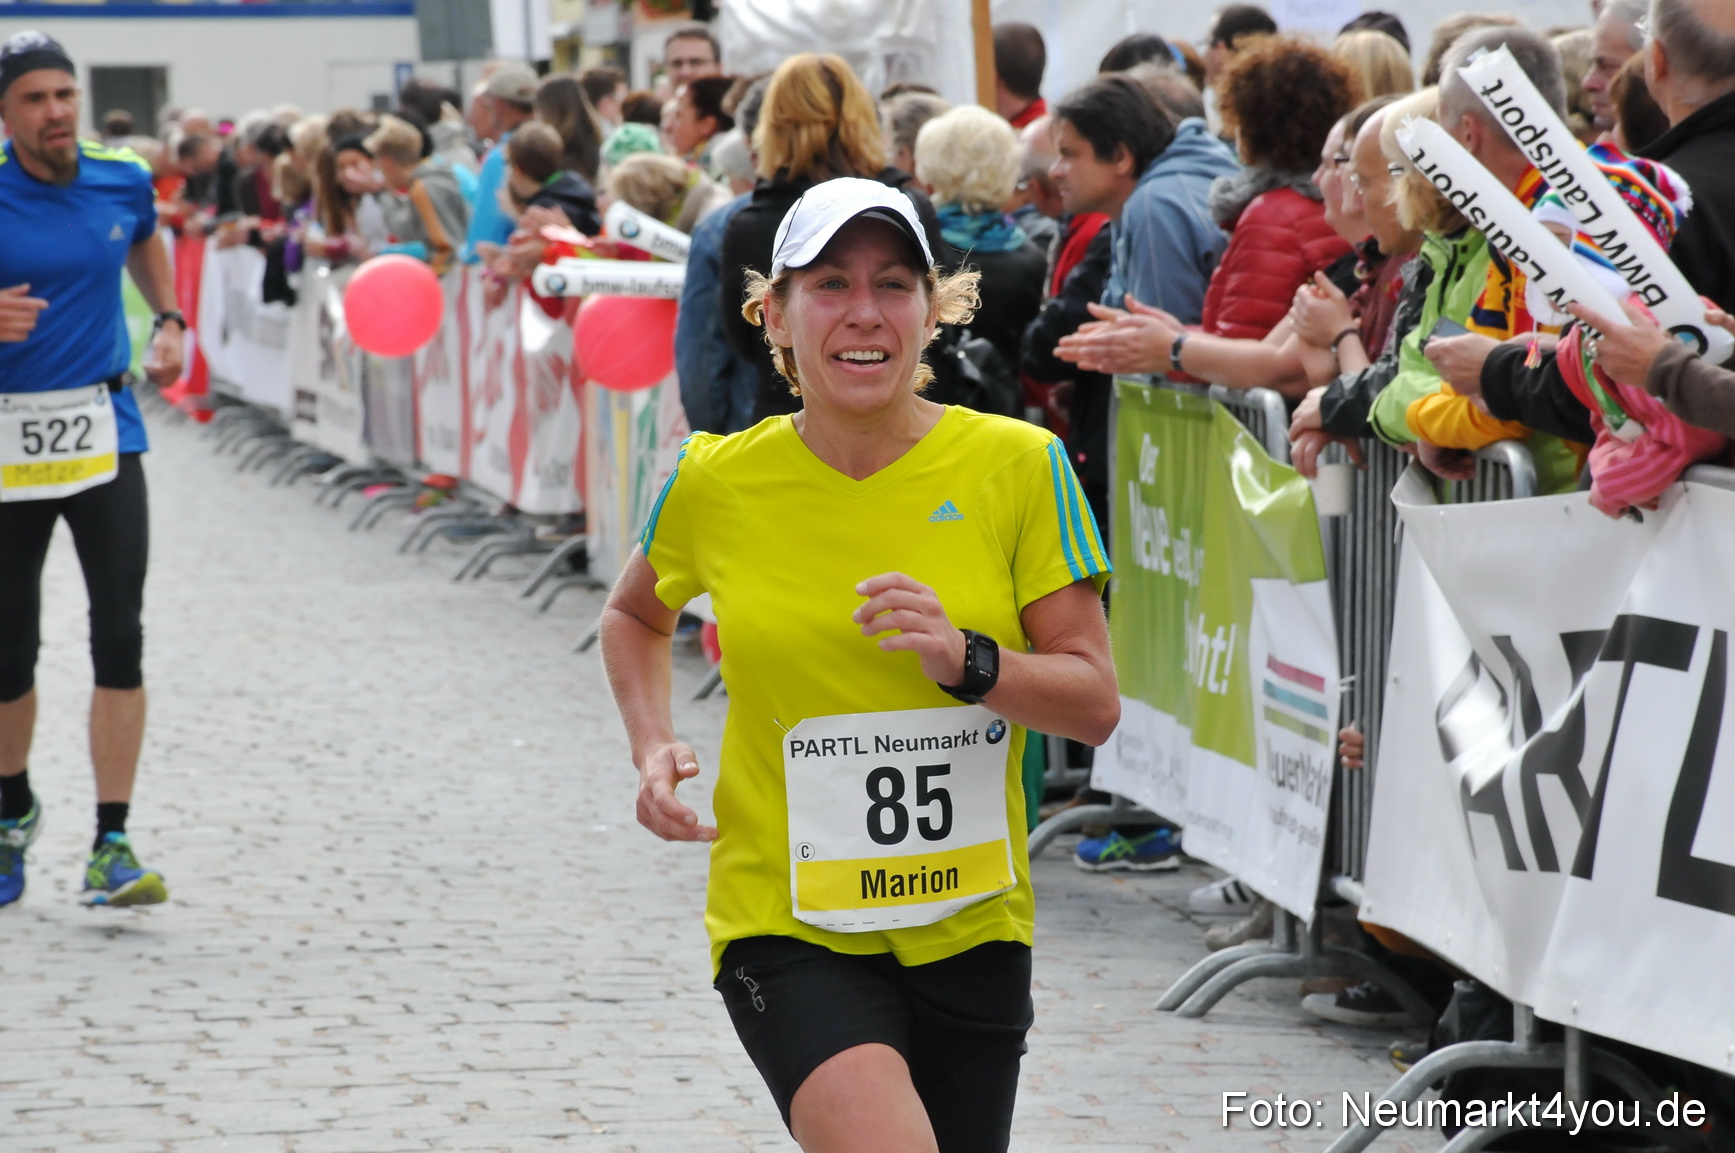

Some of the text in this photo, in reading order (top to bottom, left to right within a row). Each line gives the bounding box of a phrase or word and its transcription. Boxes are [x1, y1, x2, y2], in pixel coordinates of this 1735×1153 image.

[21, 415, 92, 455] 522
[790, 729, 979, 758] PARTL Neumarkt
[865, 762, 953, 845] 85
[801, 845, 810, 859] C
[860, 865, 959, 899] Marion
